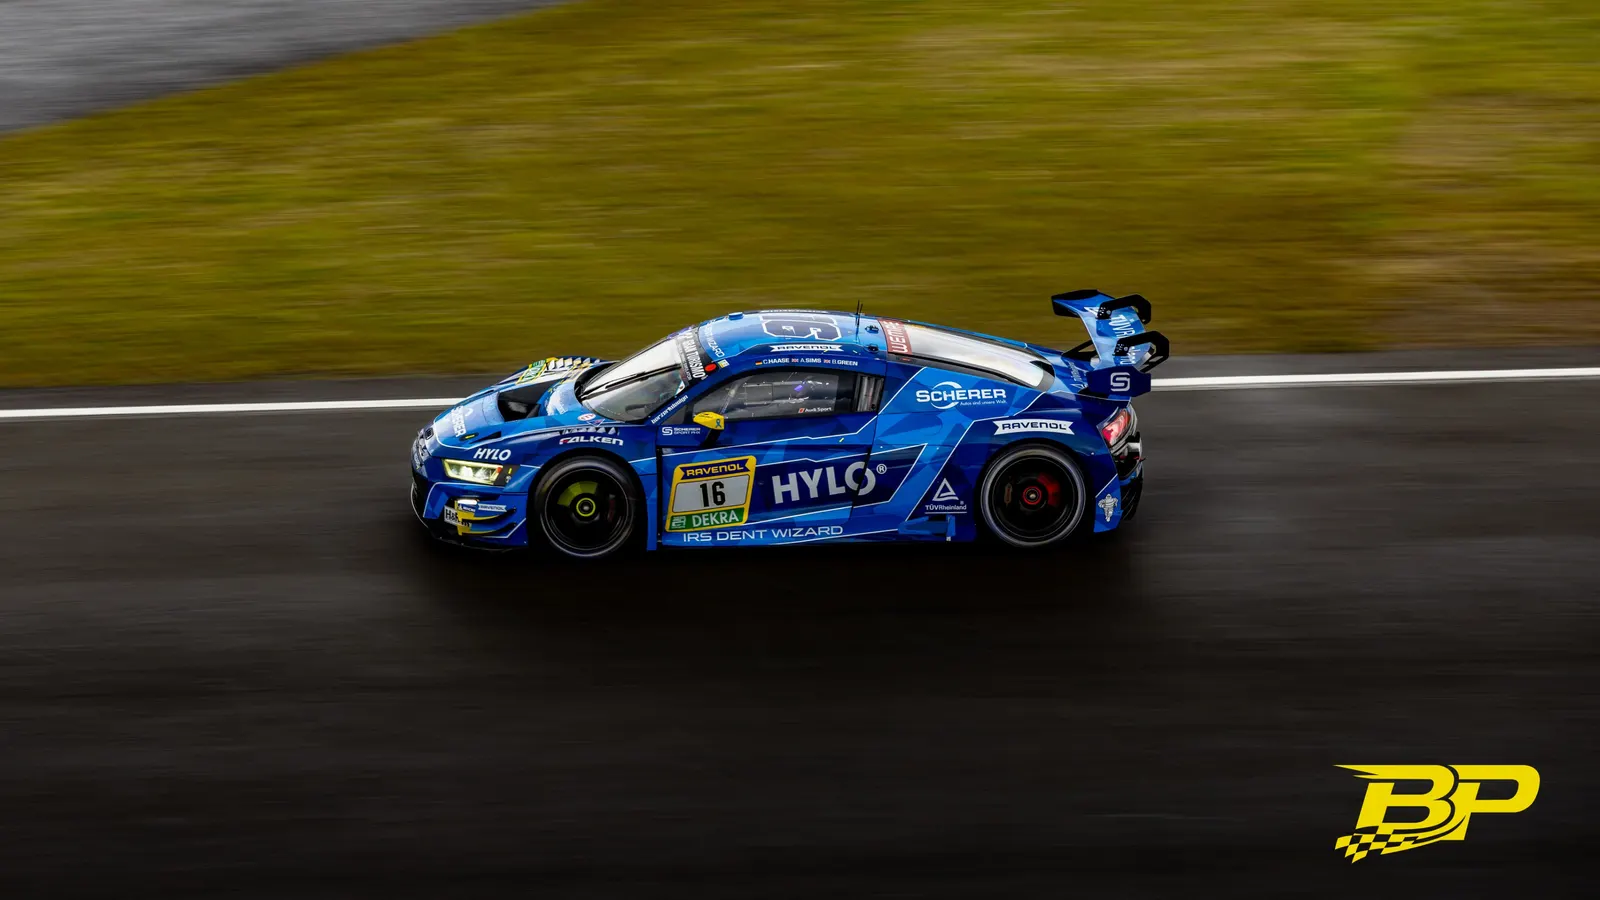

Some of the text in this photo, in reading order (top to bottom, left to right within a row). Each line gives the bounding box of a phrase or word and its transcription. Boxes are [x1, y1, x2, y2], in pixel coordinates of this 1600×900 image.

[916, 388, 1007, 403] SCHERER
[1001, 421, 1067, 430] RAVENOL
[558, 435, 624, 446] FALKEN
[472, 447, 512, 461] HYLO
[685, 463, 744, 477] RAVENOL
[699, 480, 726, 508] 16
[691, 510, 739, 528] DEKRA
[683, 525, 844, 543] IRS DENT WIZARD
